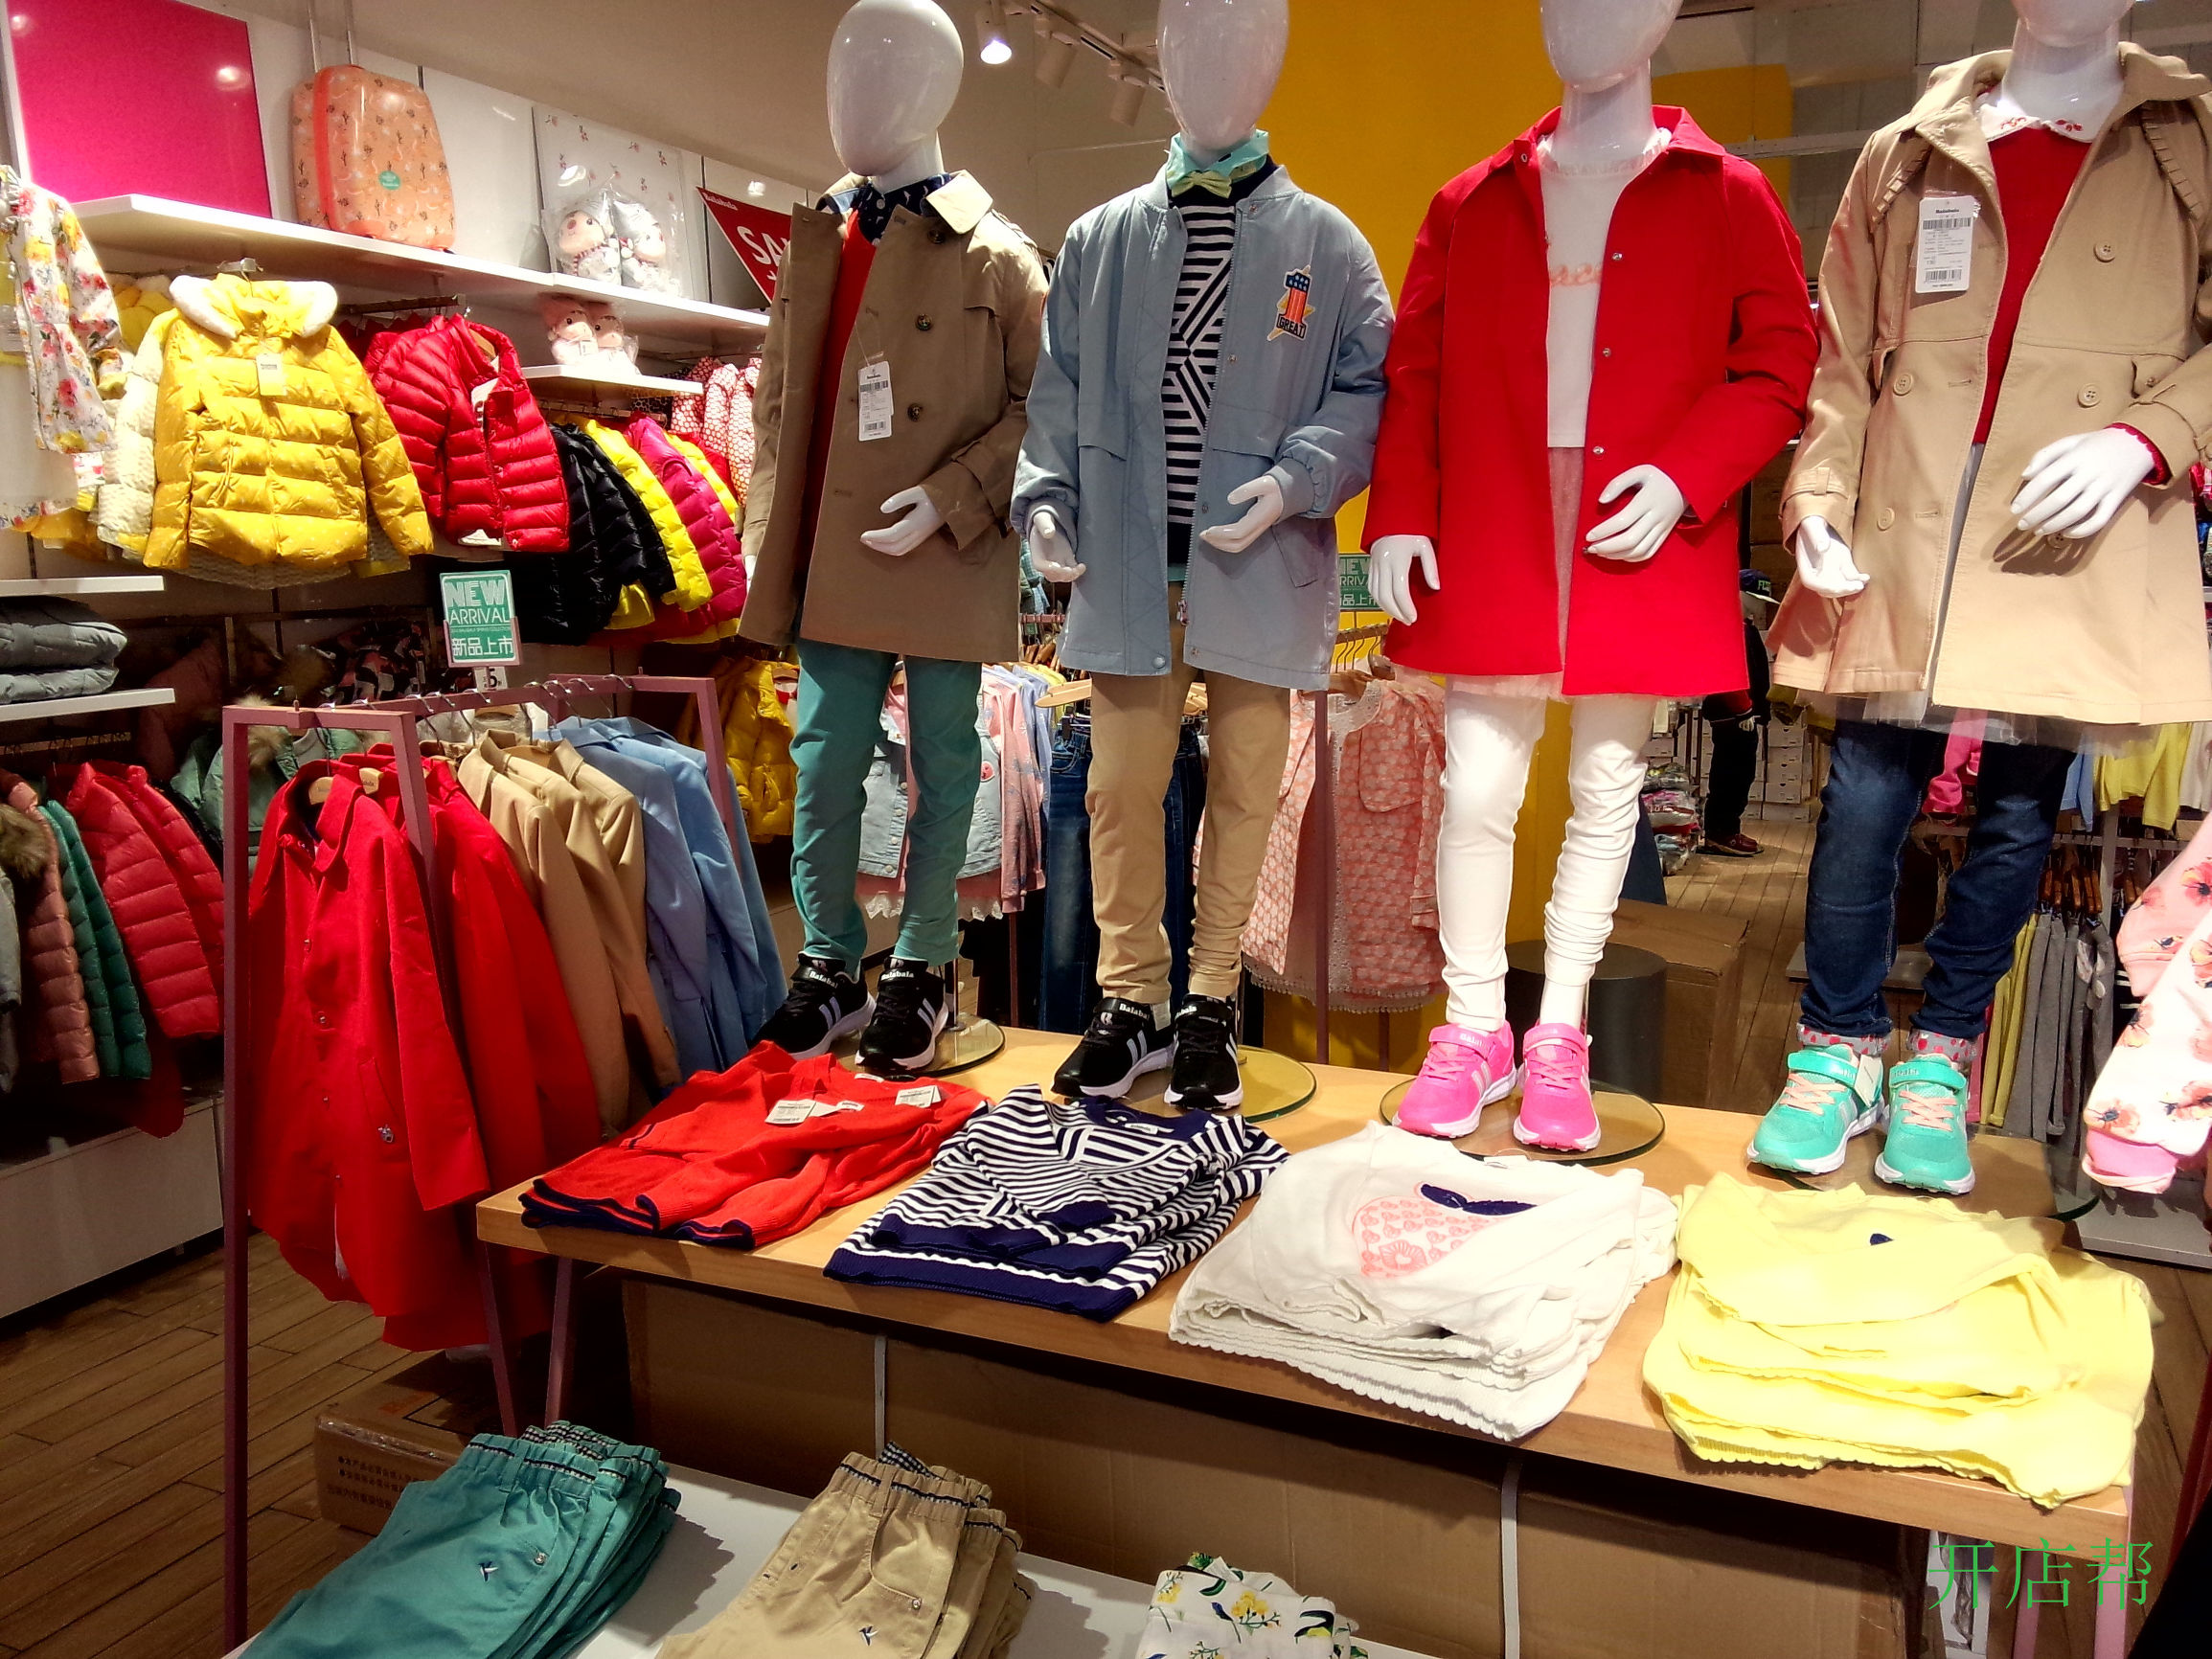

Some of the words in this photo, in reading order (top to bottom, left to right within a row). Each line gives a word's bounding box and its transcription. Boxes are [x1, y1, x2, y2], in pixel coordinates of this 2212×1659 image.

[736, 225, 791, 268] SA
[1279, 316, 1306, 338] GREAT
[445, 580, 507, 607] NEW
[449, 607, 511, 625] ARRIVAL
[451, 635, 513, 656] 新品上市
